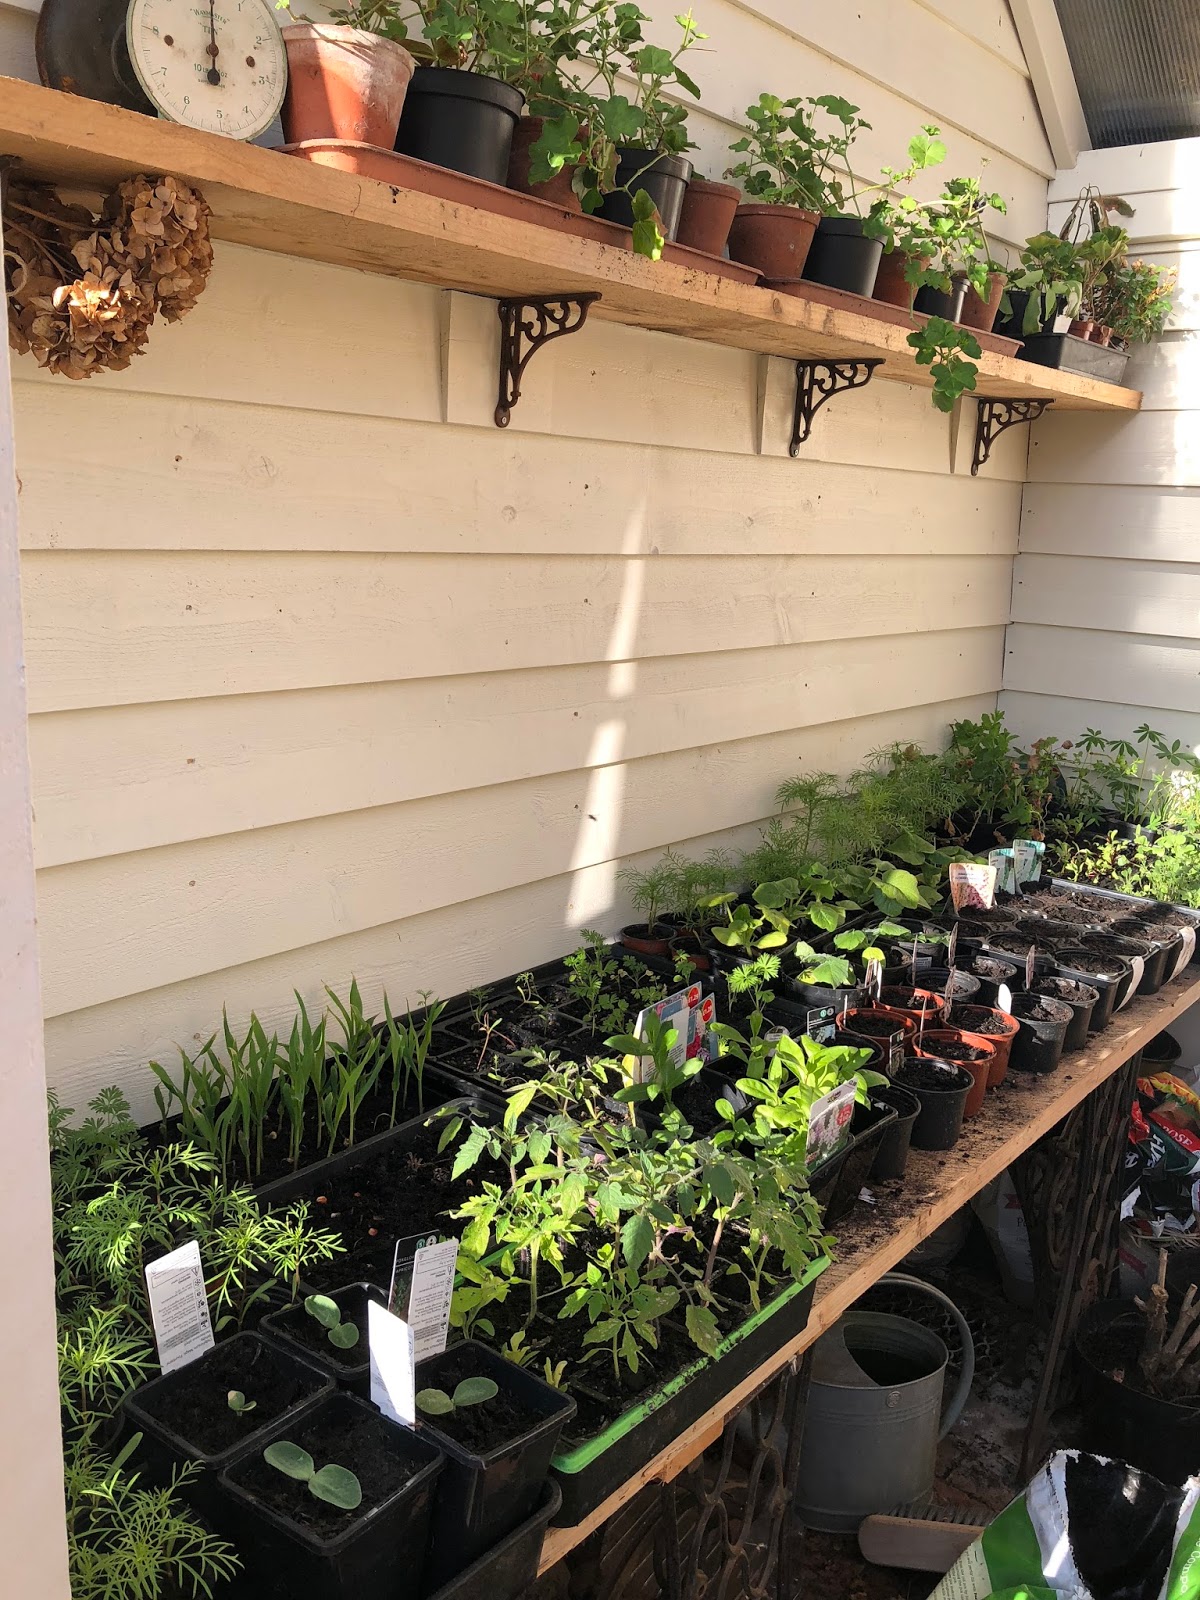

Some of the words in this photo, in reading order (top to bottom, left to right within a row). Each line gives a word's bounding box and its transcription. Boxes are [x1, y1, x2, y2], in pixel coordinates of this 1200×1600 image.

[152, 26, 160, 37] 8
[255, 36, 262, 45] 2
[160, 67, 168, 76] 7
[193, 63, 202, 72] 10
[258, 76, 265, 85] 3
[183, 96, 190, 105] 6
[216, 109, 223, 118] 5
[242, 105, 249, 114] 4
[1180, 1551, 1200, 1594] Compo
